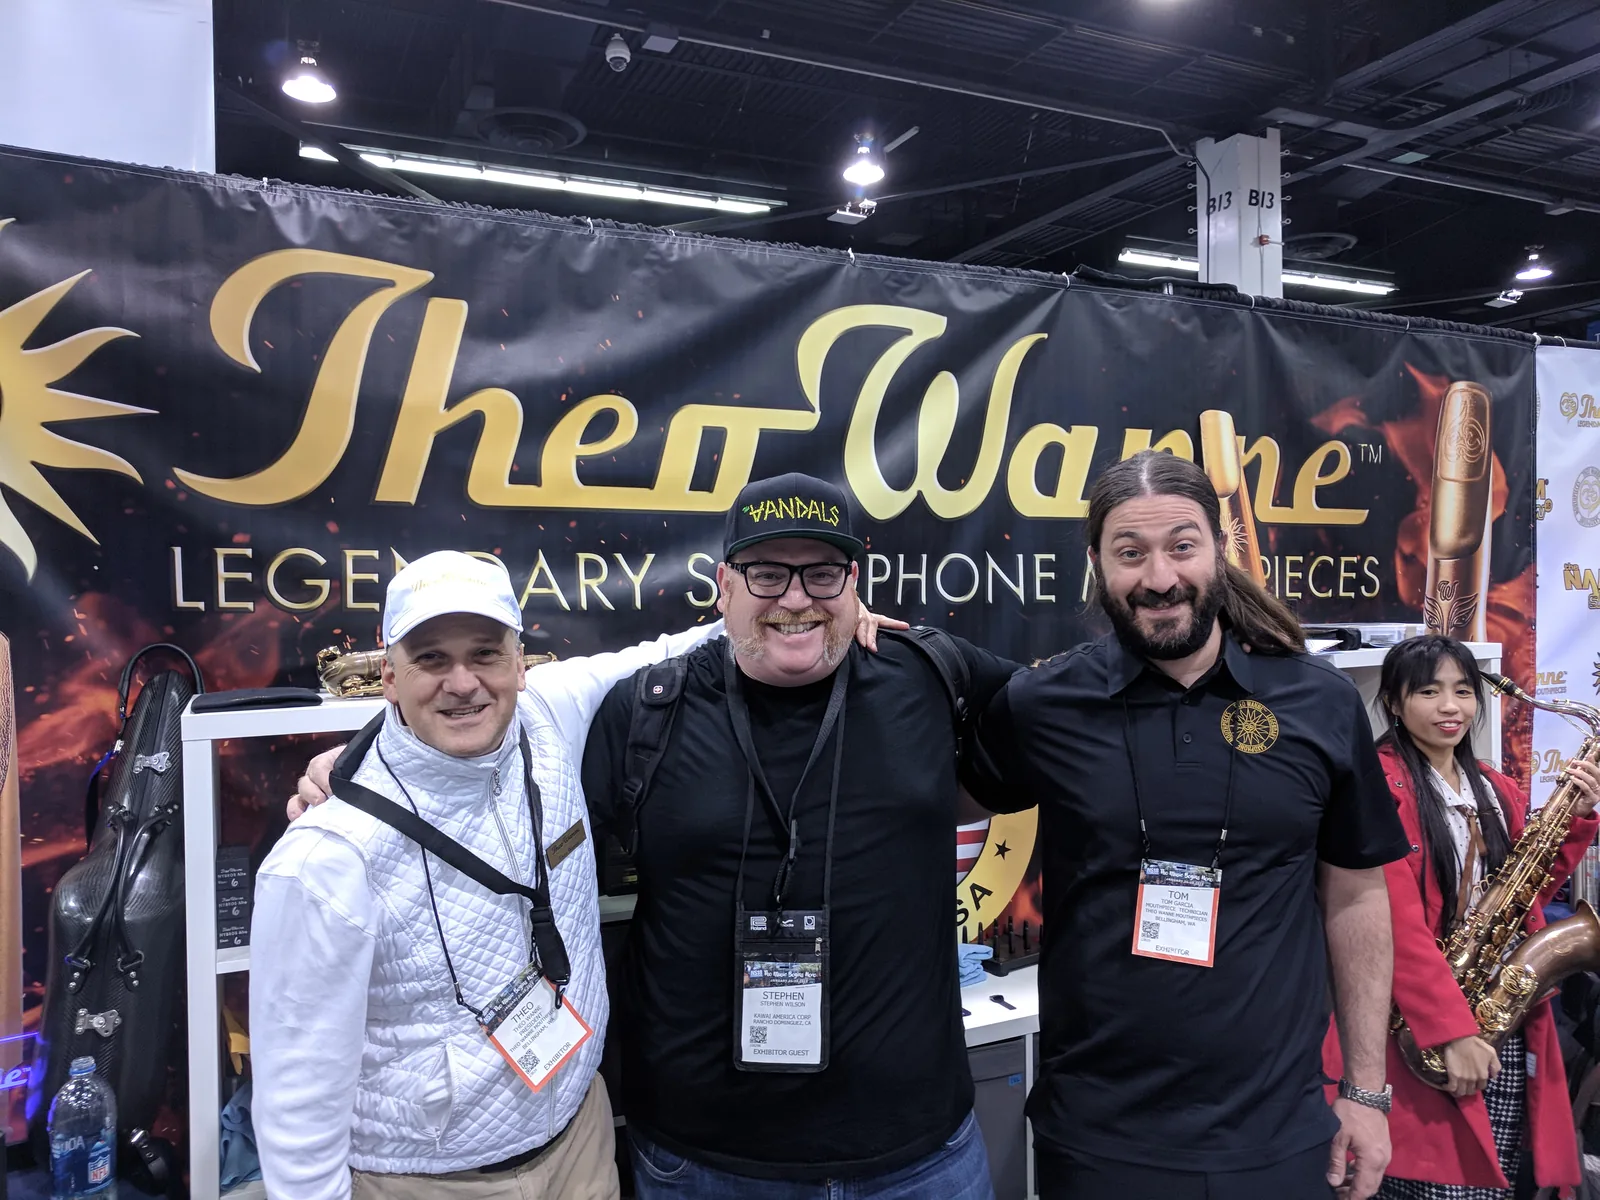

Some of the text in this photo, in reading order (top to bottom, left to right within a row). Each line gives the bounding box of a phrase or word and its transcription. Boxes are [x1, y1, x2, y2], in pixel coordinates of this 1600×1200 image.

[1248, 189, 1274, 209] B13
[173, 248, 820, 512] Theo
[171, 546, 656, 612] LEGEARY
[686, 552, 1057, 606] SPHONE
[231, 878, 239, 887] 6
[1168, 890, 1189, 901] TOM
[1174, 900, 1194, 908] GARCIA
[232, 906, 240, 916] 6
[234, 936, 241, 945] 6
[762, 991, 805, 1000] STEPHEN
[510, 1000, 535, 1024] THEO
[512, 1019, 526, 1033] THEO
[518, 1012, 543, 1036] PRESIDENT
[509, 1041, 521, 1053] THEO
[543, 1041, 571, 1070] EXHIBITOR
